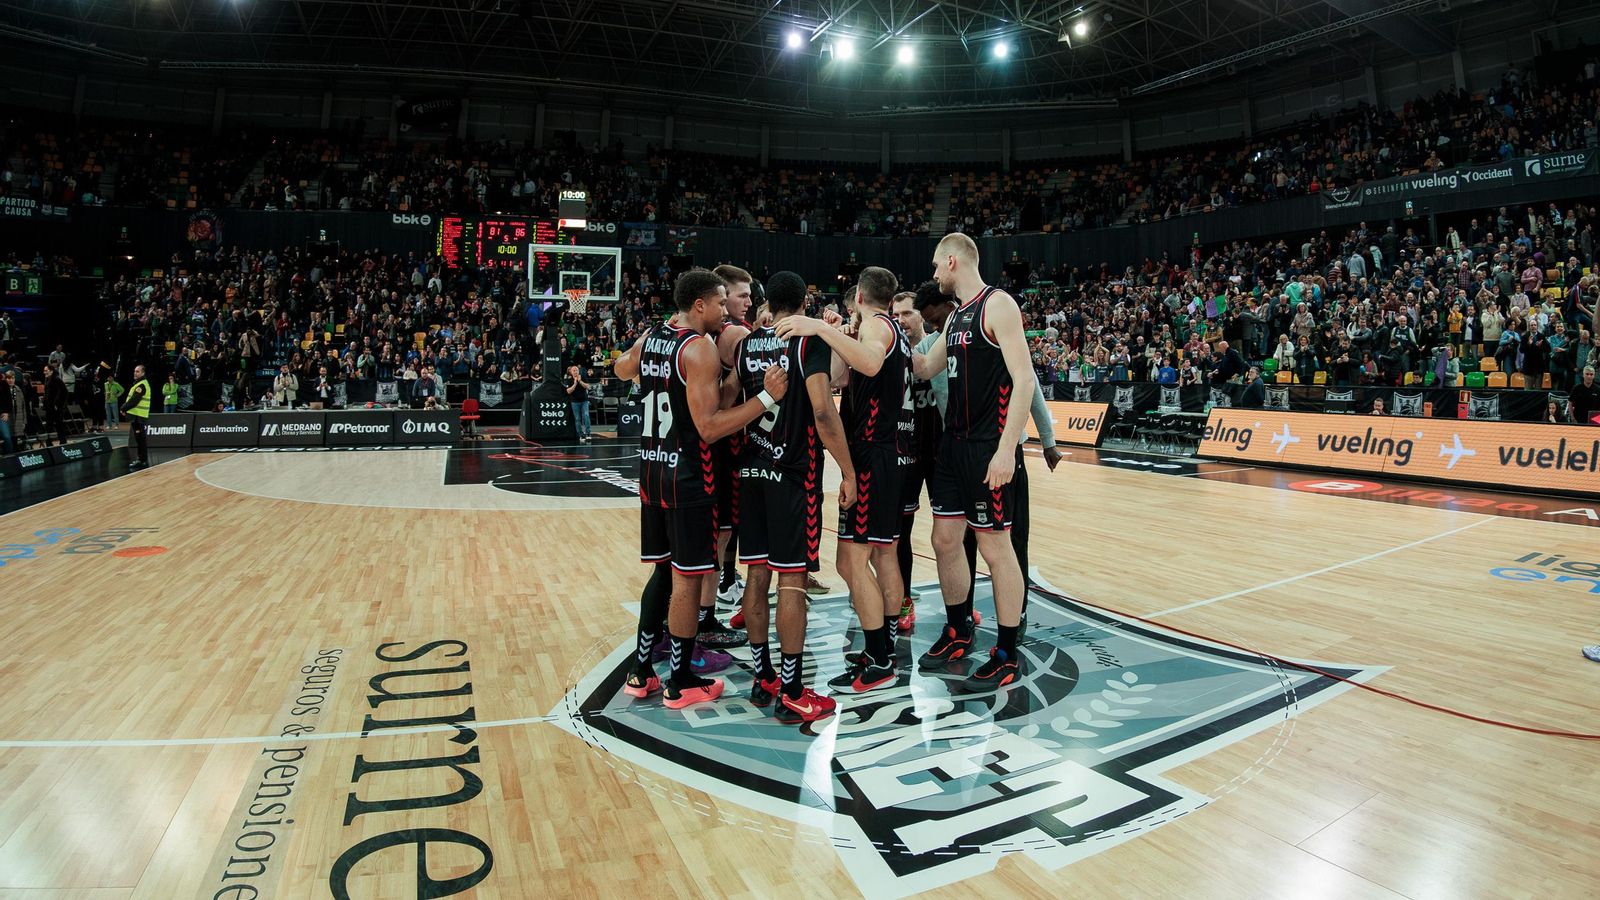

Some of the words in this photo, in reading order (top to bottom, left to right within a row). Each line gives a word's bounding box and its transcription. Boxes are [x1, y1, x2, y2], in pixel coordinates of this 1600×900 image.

[1543, 153, 1585, 168] surne
[1412, 173, 1457, 188] vueling
[1472, 168, 1513, 181] Occident
[562, 190, 585, 199] 10:00
[5, 206, 32, 217] CAUSA
[393, 213, 419, 224] bbk
[497, 245, 517, 255] 10:00
[10, 278, 19, 290] B
[541, 410, 558, 418] bbk
[641, 390, 673, 439] 19
[147, 424, 187, 435] hummel
[199, 425, 249, 433] azulmarino
[281, 423, 322, 431] MEDRANO
[344, 423, 390, 434] Petronor
[416, 422, 451, 434] IMQ
[1317, 426, 1414, 467] vueling
[290, 648, 343, 721] seguros
[281, 722, 316, 739] &
[329, 639, 494, 900] surne
[213, 747, 307, 900] pensione
